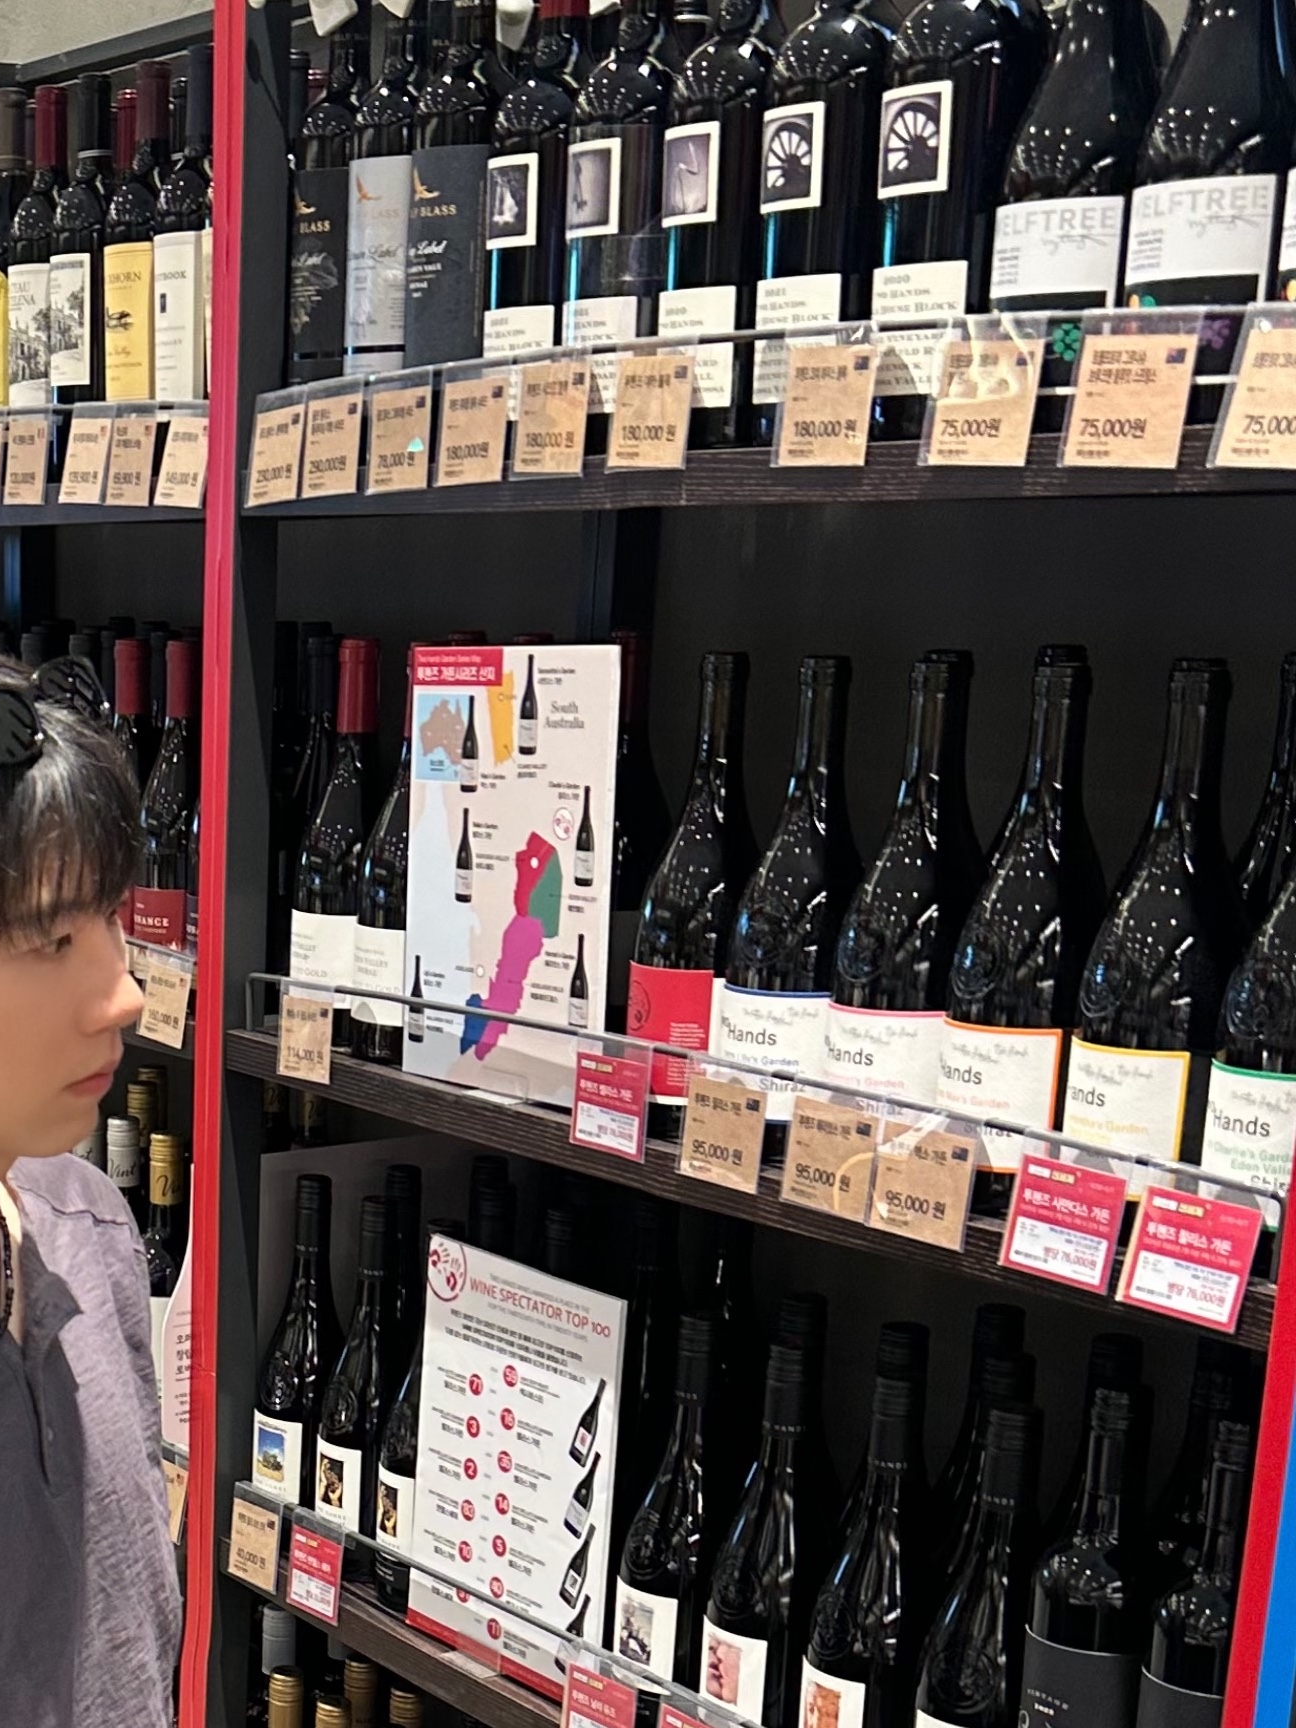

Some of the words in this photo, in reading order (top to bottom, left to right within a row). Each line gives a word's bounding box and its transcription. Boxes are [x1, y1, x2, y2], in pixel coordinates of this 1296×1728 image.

[941, 419, 1002, 438] 75,000원
[1079, 418, 1147, 439] 75,000원
[551, 701, 578, 714] South
[544, 718, 585, 730] Australia
[727, 1024, 777, 1046] Hands
[760, 1055, 800, 1067] Garden
[828, 1044, 874, 1066] Hands
[759, 1078, 806, 1093] Shiraz
[1067, 1085, 1106, 1107] ands
[856, 1099, 904, 1116] Shiraz
[1212, 1110, 1271, 1137] Hands
[692, 1139, 729, 1161] 95,000
[731, 1150, 744, 1166] 원
[795, 1163, 836, 1187] 95,000
[838, 1174, 851, 1192] 원
[885, 1190, 930, 1215] 95,000
[932, 1201, 946, 1220] 원
[1023, 1188, 1050, 1208] 투핸즈
[1090, 1204, 1111, 1224] 가든
[1146, 1222, 1176, 1240] 투핸즈
[1210, 1236, 1232, 1256] 가든
[470, 1276, 497, 1300] WINE
[500, 1289, 563, 1321] SPECTATOR
[565, 1310, 589, 1329] TOP
[591, 1321, 611, 1338] 100
